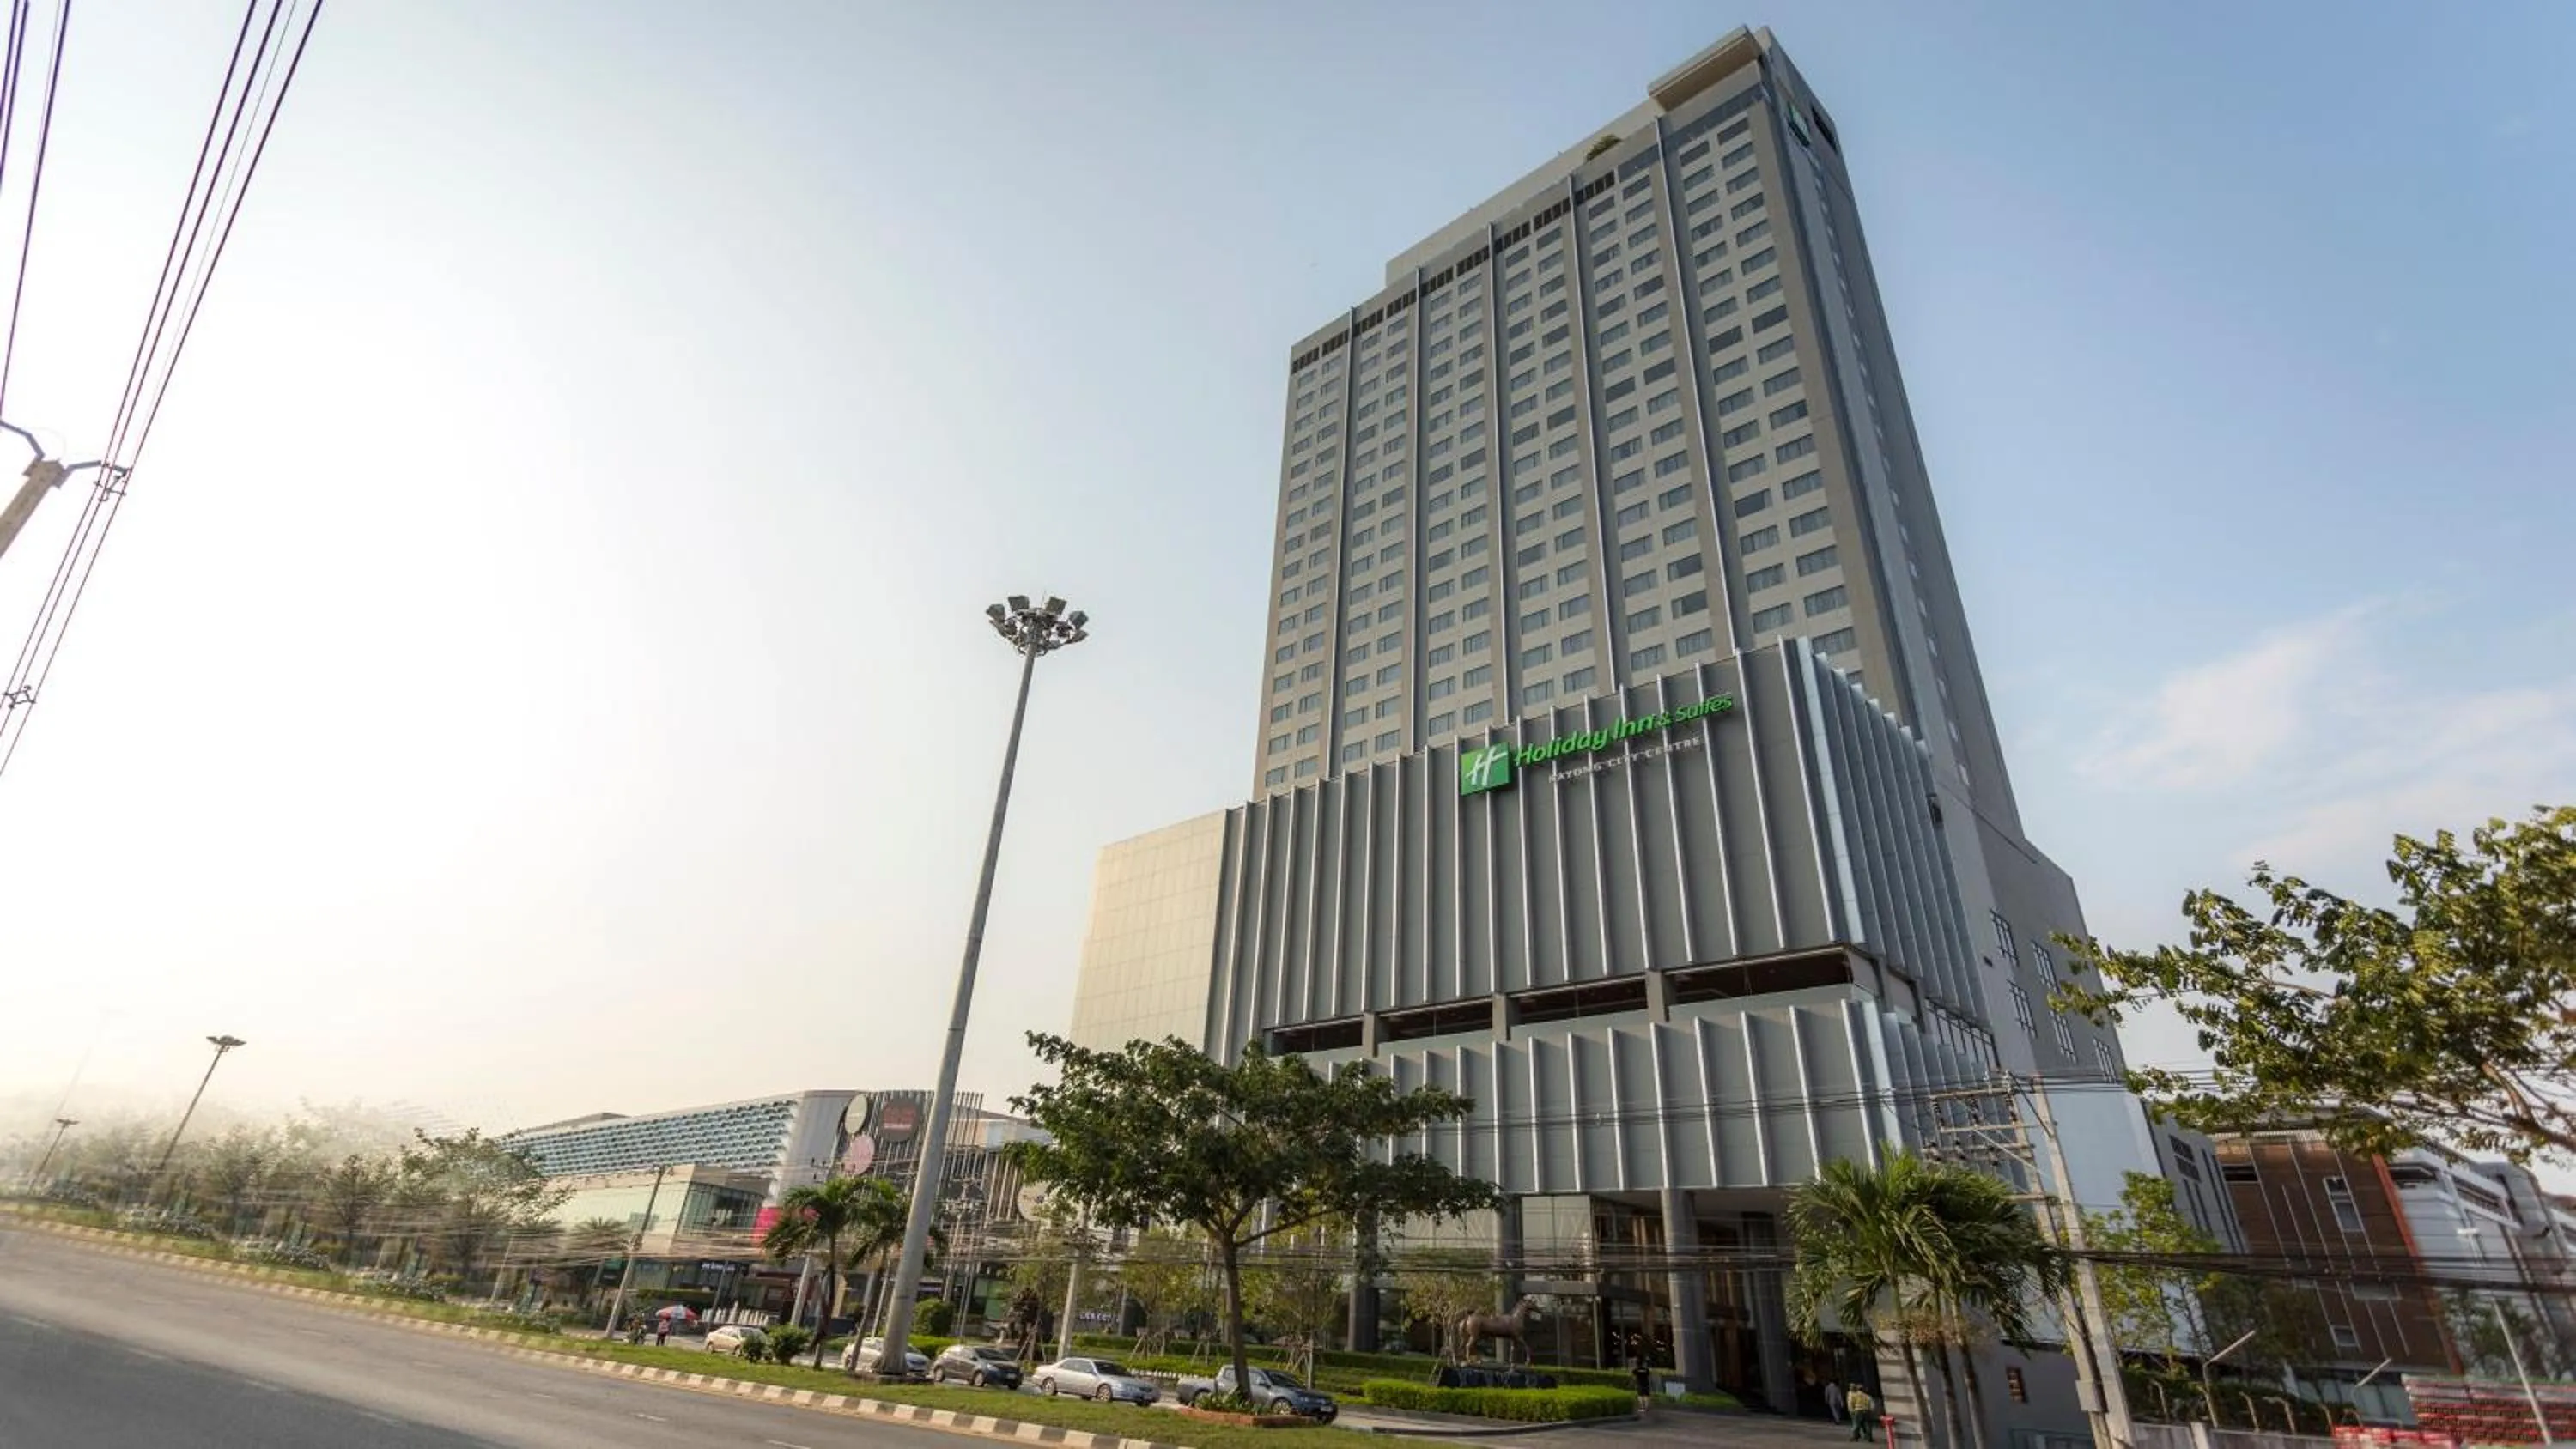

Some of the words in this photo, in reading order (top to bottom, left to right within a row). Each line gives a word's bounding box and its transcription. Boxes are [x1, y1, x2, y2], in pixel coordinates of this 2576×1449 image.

[1515, 728, 1608, 766] Holiday
[1611, 713, 1654, 741] Inn
[1657, 711, 1673, 728] &
[1675, 694, 1733, 723] Suites
[1548, 761, 1602, 784] RAYONG
[1607, 753, 1639, 767] CITY
[1644, 736, 1701, 759] CENTRE
